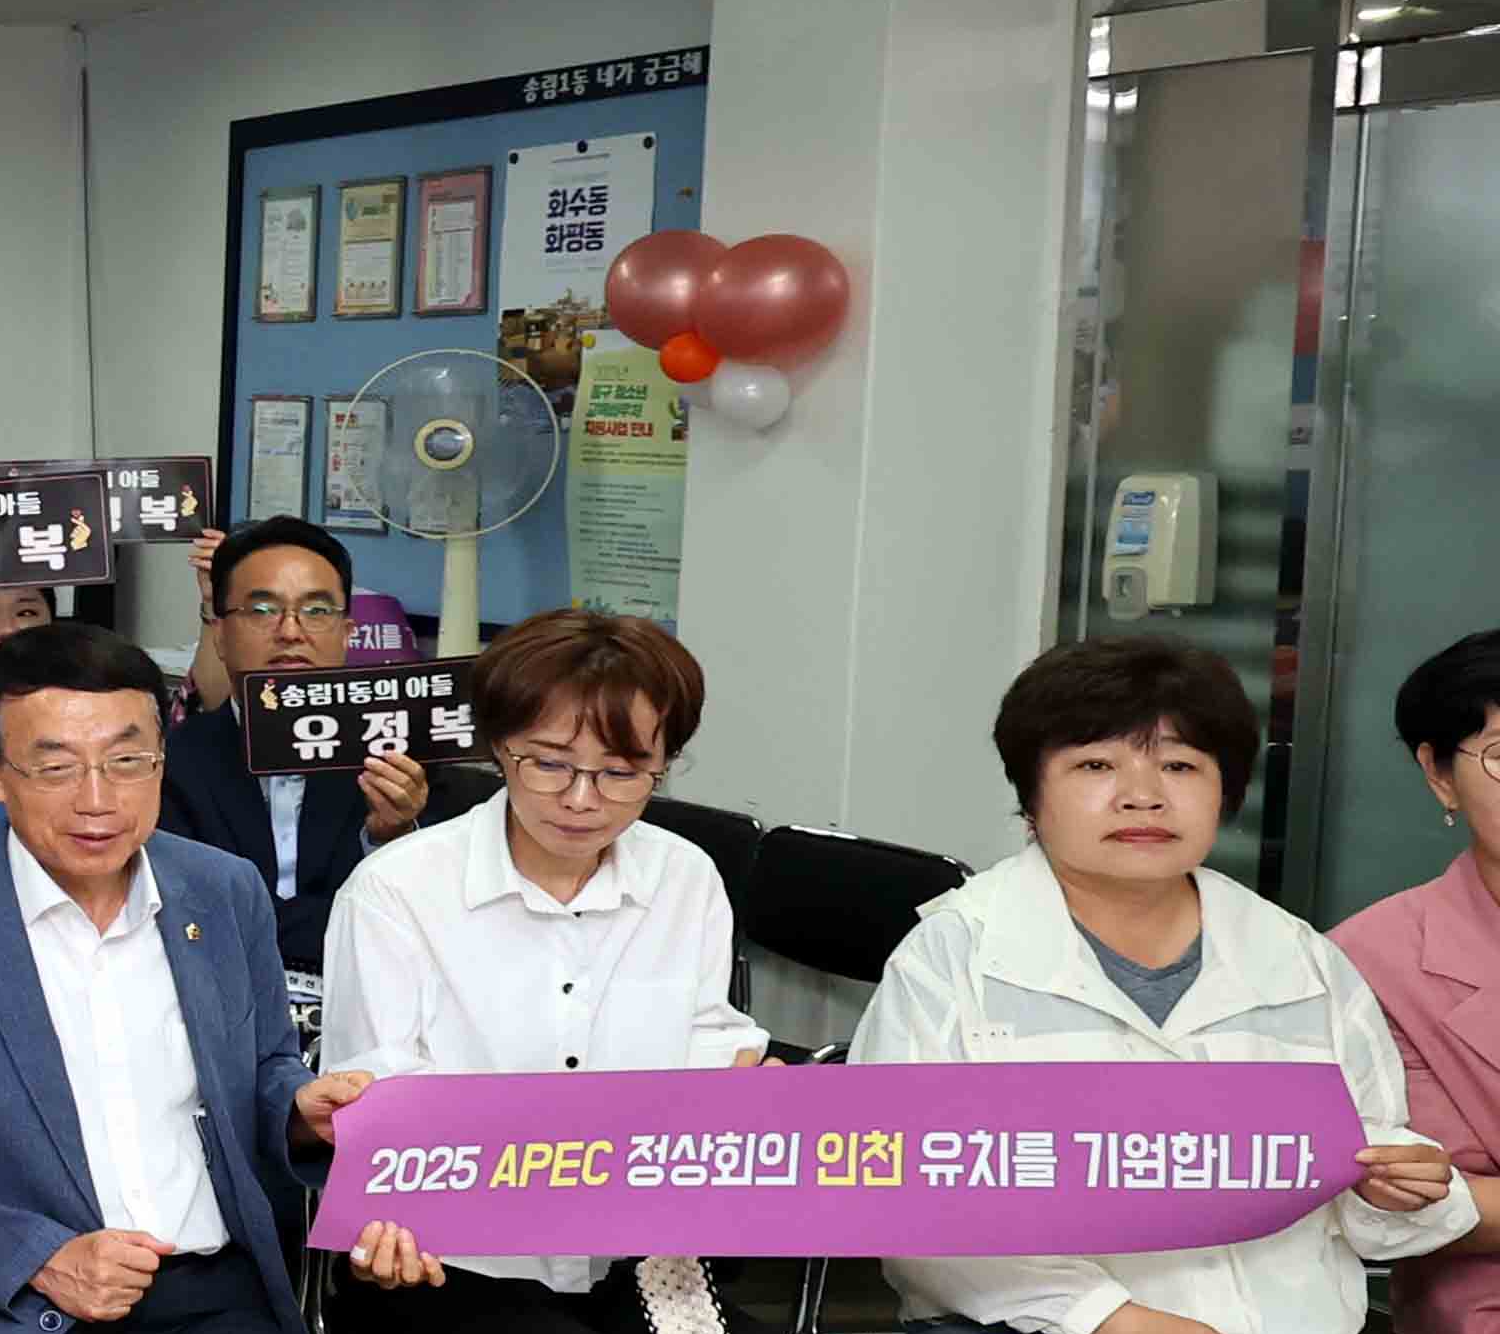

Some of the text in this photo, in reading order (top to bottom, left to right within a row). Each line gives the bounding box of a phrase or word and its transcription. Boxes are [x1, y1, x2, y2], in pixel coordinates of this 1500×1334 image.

[524, 68, 588, 103] 송림1동
[548, 185, 608, 219] 화수동
[544, 221, 605, 253] 화평동
[119, 469, 160, 489] 아들
[280, 674, 453, 707] 송림1동의 아들
[364, 1132, 1321, 1194] 2025 APEC 정상회의 인천 유치를 기원합니다.
